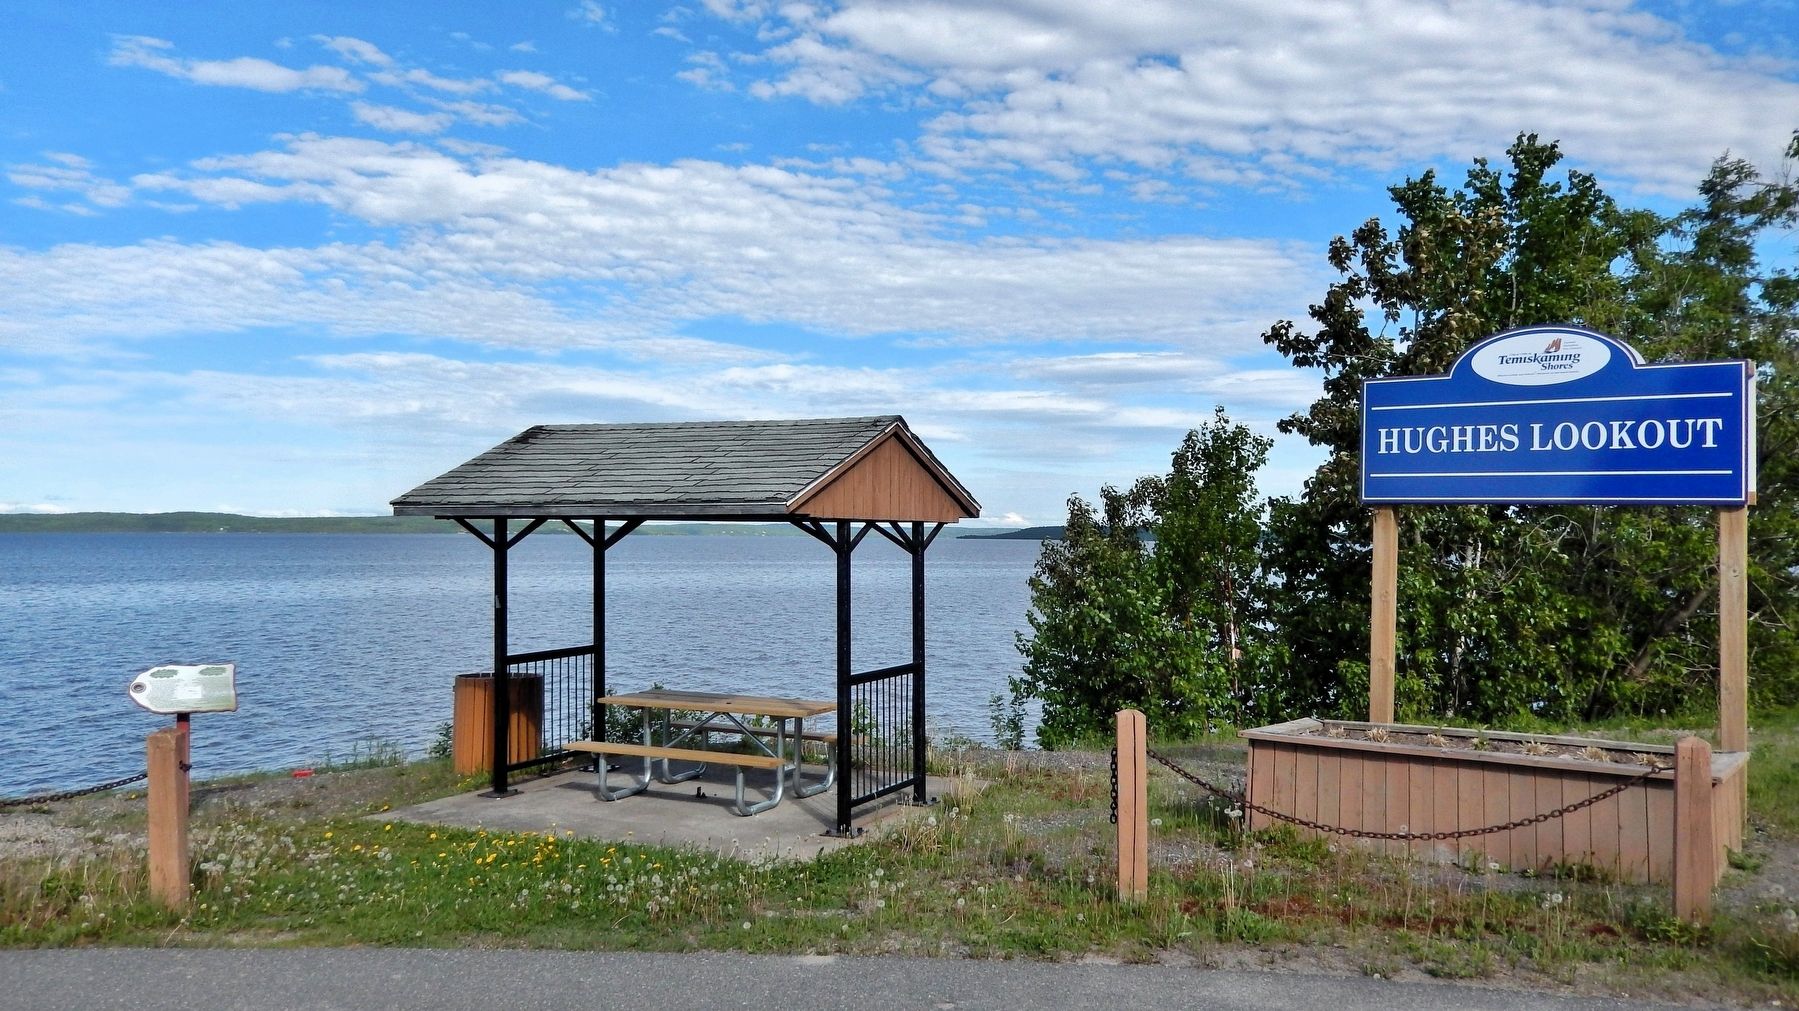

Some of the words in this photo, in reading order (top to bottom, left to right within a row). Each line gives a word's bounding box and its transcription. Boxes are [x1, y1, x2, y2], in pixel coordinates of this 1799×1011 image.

[1498, 352, 1581, 365] Temiskaming
[1541, 362, 1574, 371] Shores
[1378, 424, 1520, 454] HUGHES
[1529, 418, 1723, 452] LOOKOUT
